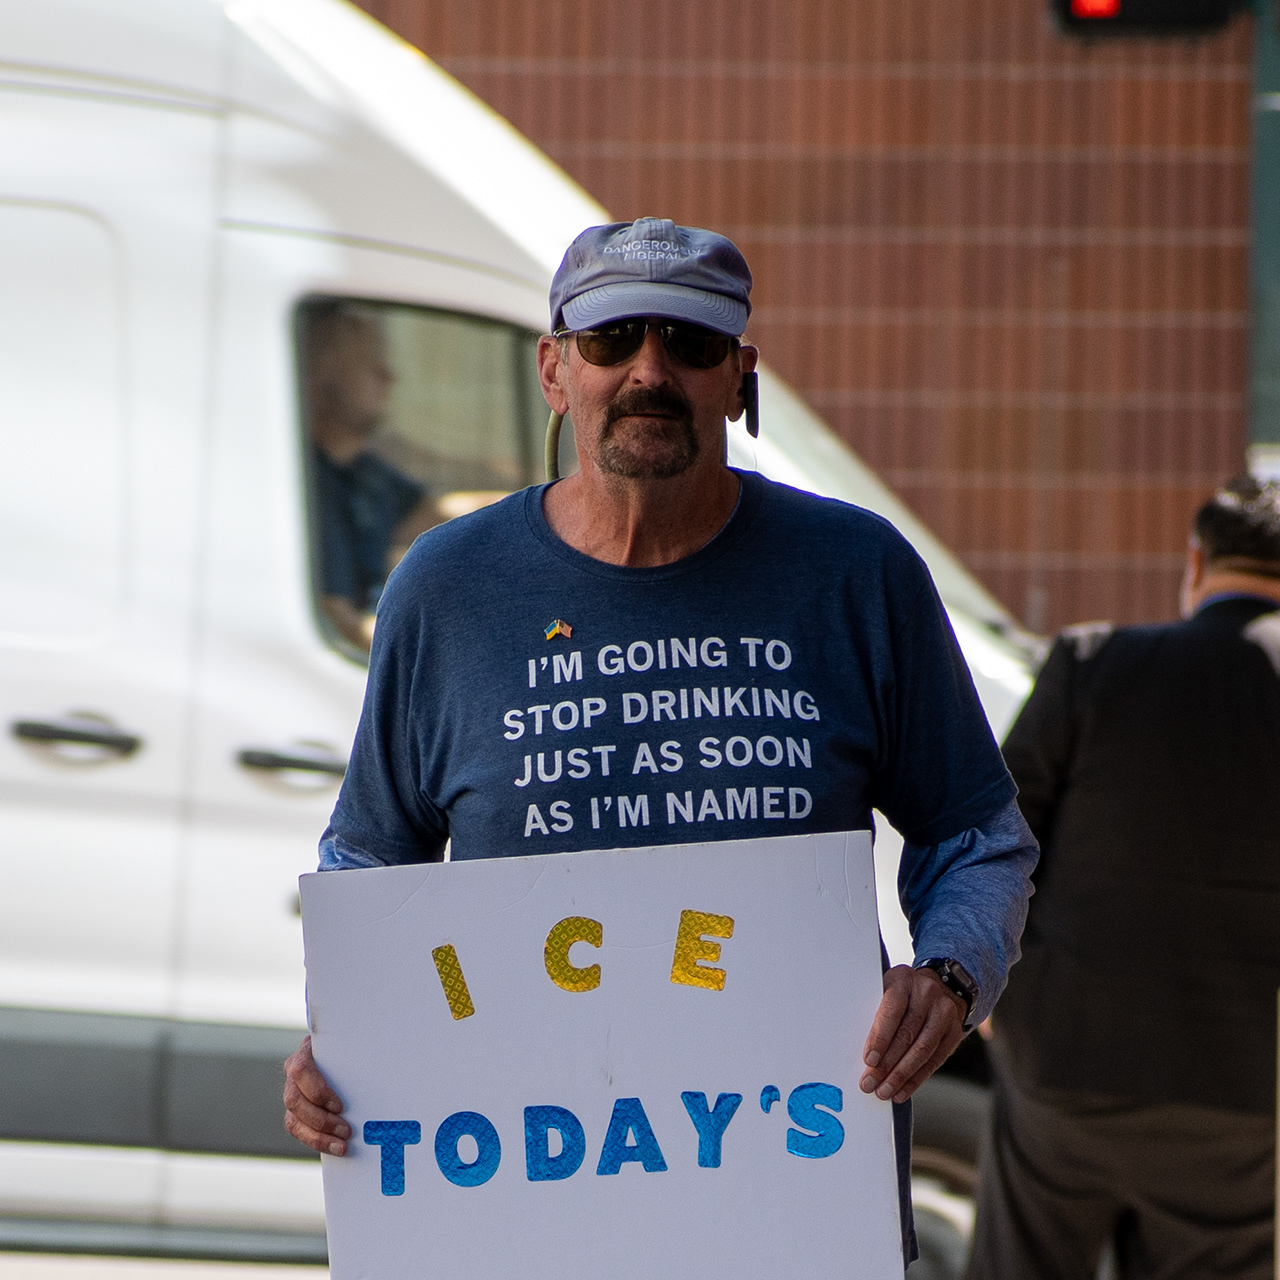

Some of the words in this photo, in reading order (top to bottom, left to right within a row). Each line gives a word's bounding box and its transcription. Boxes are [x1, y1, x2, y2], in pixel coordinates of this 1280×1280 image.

[528, 651, 583, 688] I'M
[597, 637, 727, 675] GOING
[740, 638, 792, 670] TO
[503, 697, 608, 741] STOP
[623, 687, 820, 724] DRINKING
[514, 745, 616, 787] JUST
[632, 740, 684, 774] AS
[699, 736, 812, 769] SOON
[524, 800, 573, 837] AS
[591, 794, 649, 829] I'M
[666, 787, 813, 824] NAMED
[431, 909, 735, 1021] ICE
[363, 1082, 845, 1197] TODAY'S
